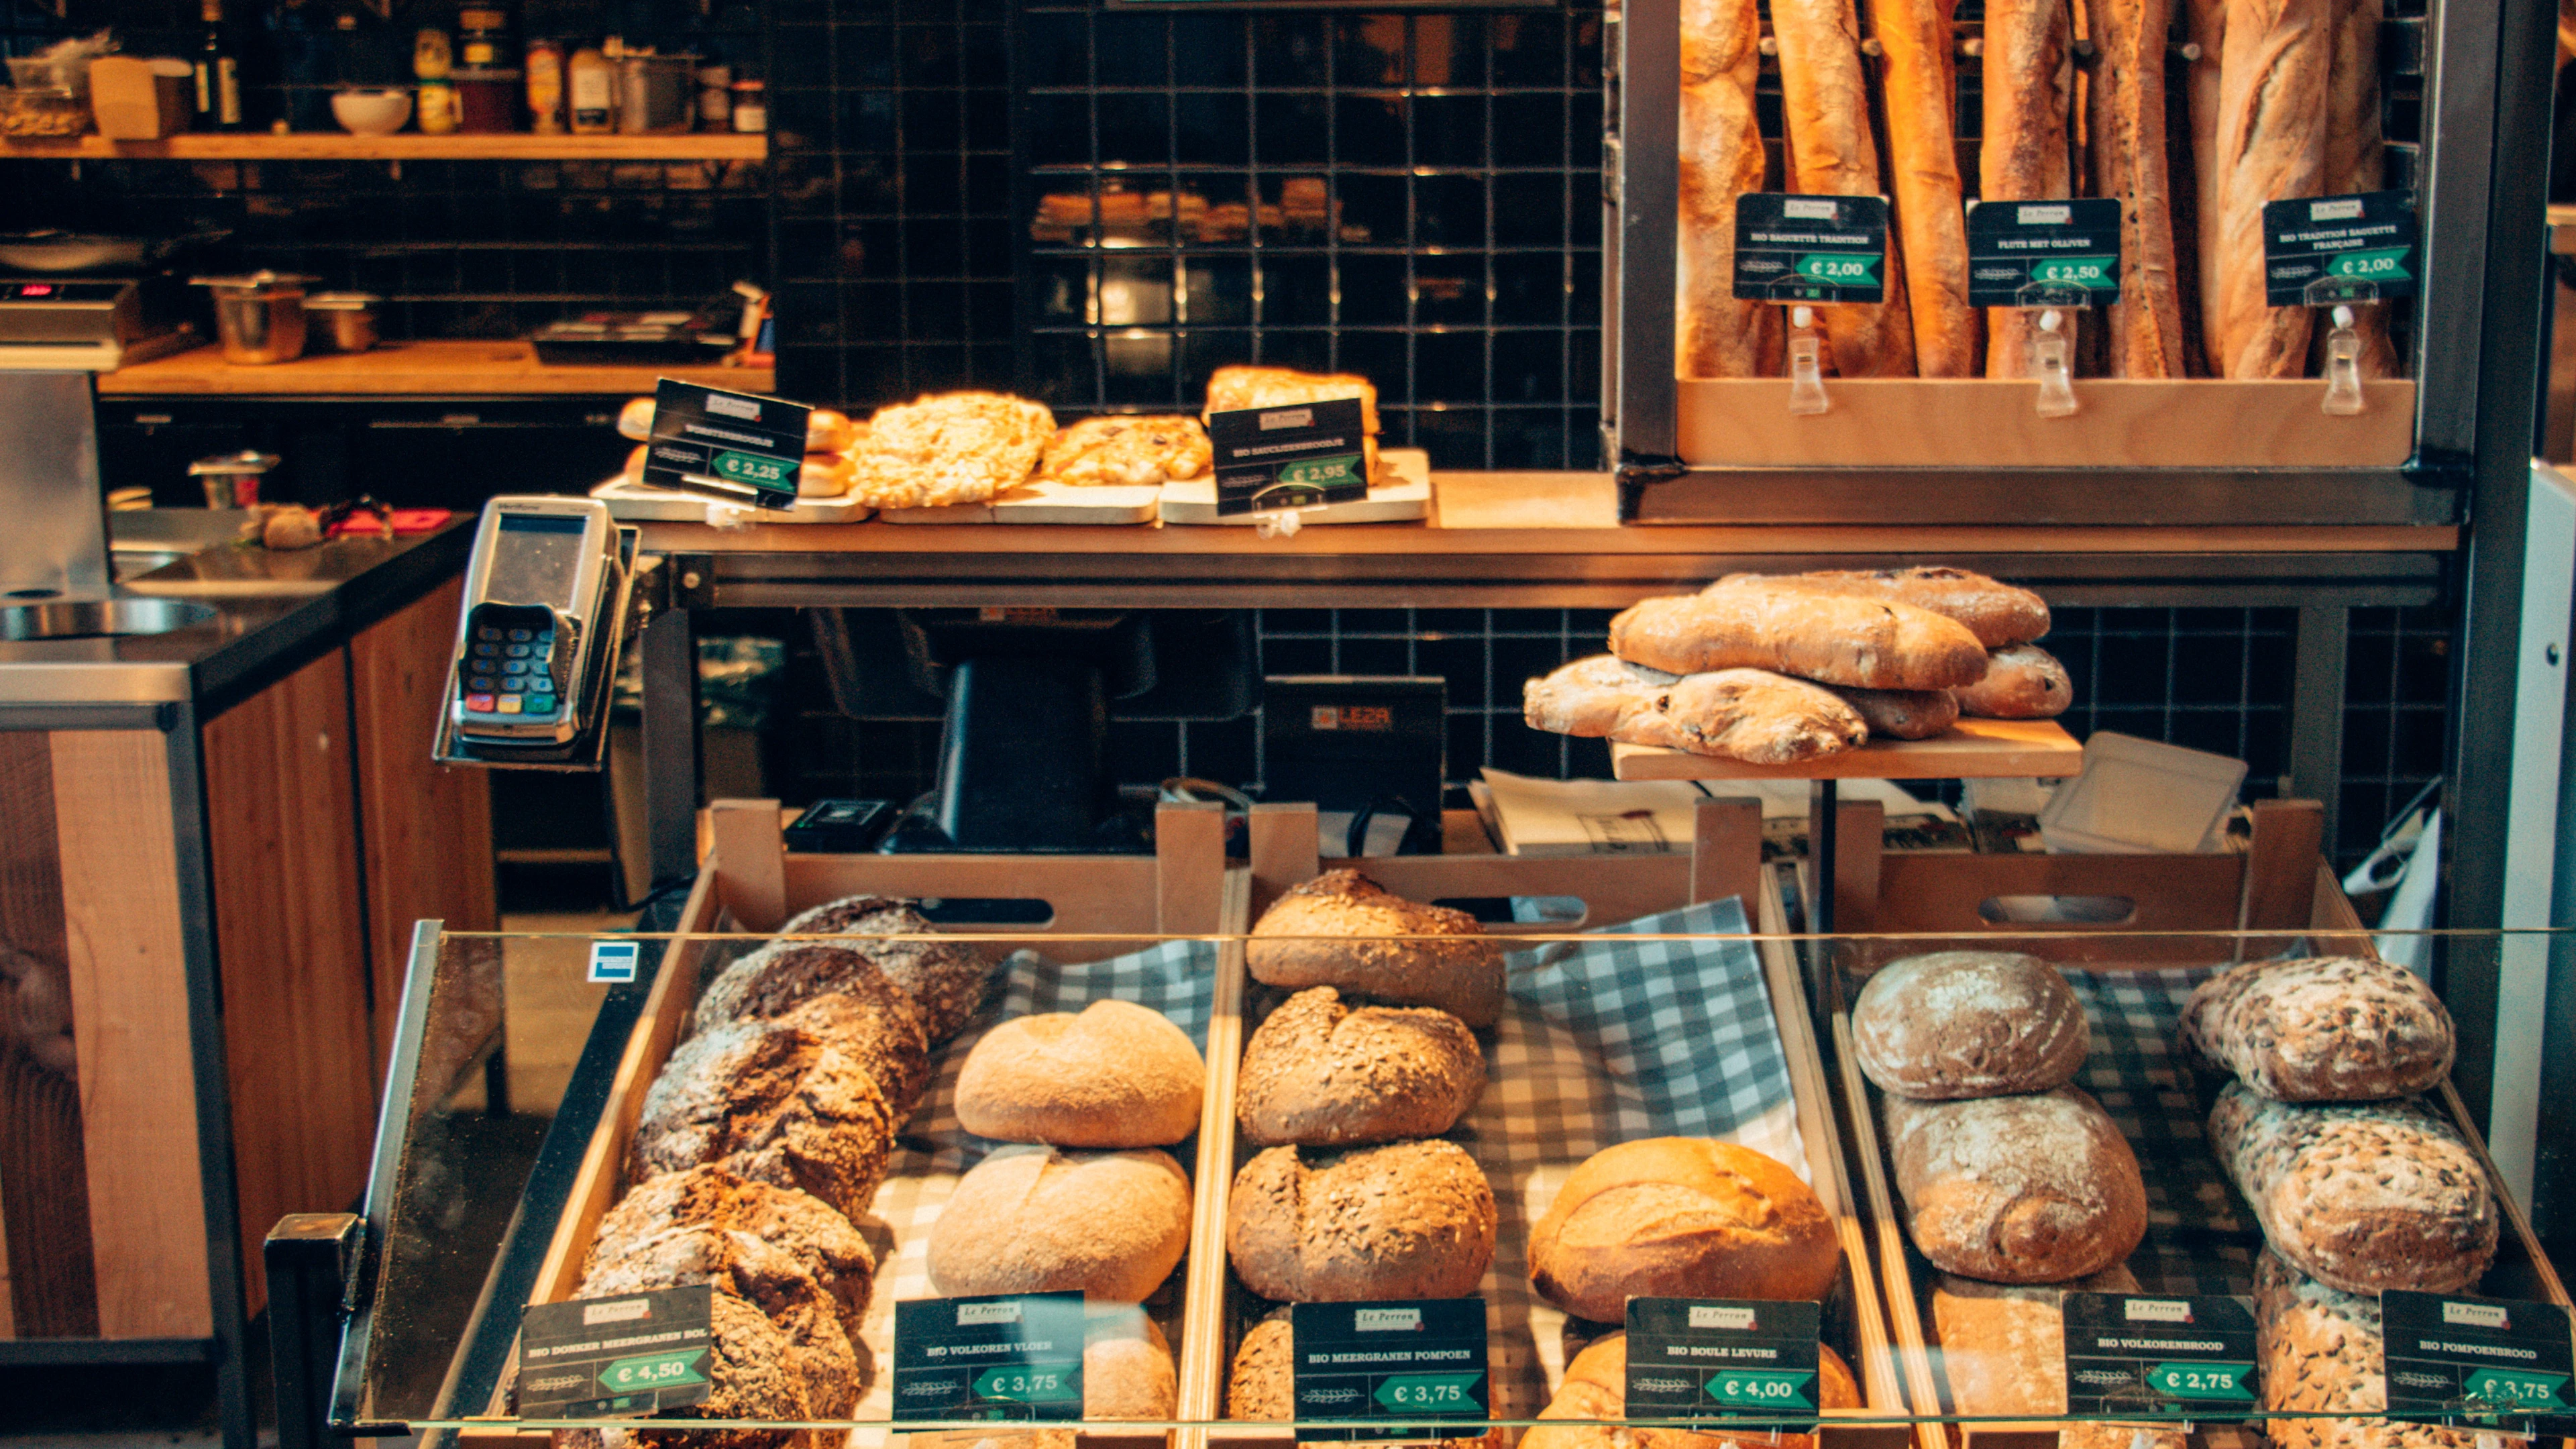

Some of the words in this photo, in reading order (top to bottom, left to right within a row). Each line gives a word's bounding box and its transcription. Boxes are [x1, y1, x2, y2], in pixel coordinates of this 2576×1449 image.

[1751, 233, 1767, 241] BIO
[1769, 233, 1817, 243] BAGUETTE
[1819, 235, 1870, 244] TRADITION
[2279, 234, 2296, 243] BIO
[2298, 230, 2347, 241] TRADITION
[2349, 225, 2396, 236] BAGUETTE
[1998, 240, 2027, 249] FLUTE
[2029, 240, 2049, 248] MET
[1811, 262, 1822, 274] €
[1827, 263, 1864, 276] 2,00
[2047, 266, 2057, 279] €
[2062, 266, 2100, 280] 2,50
[2342, 261, 2353, 274] €
[2359, 258, 2394, 273] 2,00
[1232, 449, 1250, 458] BIO
[727, 459, 739, 472] €
[743, 462, 780, 480] 2,25
[1293, 469, 1305, 482] €
[1309, 465, 1346, 481] 2,95
[965, 1307, 976, 1316] Le
[981, 1305, 1015, 1315] Perron
[1696, 1310, 1708, 1319] Le
[1712, 1311, 1747, 1320] Perron
[2132, 1303, 2144, 1311] Le
[2148, 1304, 2182, 1313] Perron
[2450, 1307, 2461, 1315] Le
[2465, 1308, 2500, 1318] Perron
[1362, 1313, 1374, 1322] Le
[1379, 1312, 1413, 1322] Perron
[529, 1348, 549, 1358] BIO
[551, 1342, 600, 1356] DONKER
[602, 1332, 682, 1348] MEERGRANEN
[683, 1328, 708, 1340] BOL
[927, 1347, 947, 1356] BIO
[950, 1343, 1011, 1355] VOLKOREN
[1014, 1341, 1053, 1352] VLOER
[2098, 1338, 2118, 1348] BIO
[2121, 1338, 2224, 1350] VOLKORENBROOD
[2419, 1340, 2440, 1350] BIO
[2443, 1342, 2537, 1360] POMPOENBROOD
[1309, 1354, 1330, 1364] BIO
[1332, 1351, 1411, 1362] MEERGRANEN
[1415, 1350, 1470, 1360] POMPOEN
[1667, 1346, 1688, 1356] BIO
[1690, 1346, 1729, 1357] BOULE
[1731, 1348, 1777, 1358] LEVURE
[617, 1368, 632, 1382] €
[638, 1362, 685, 1381] 4,50
[992, 1377, 1005, 1393] €
[1012, 1375, 1057, 1393] 3,75
[2166, 1373, 2180, 1387] €
[2187, 1373, 2233, 1391] 2,75
[1394, 1387, 1407, 1402] €
[1415, 1385, 1460, 1404] 3,75
[1725, 1381, 1739, 1395] €
[1746, 1382, 1792, 1399] 4,00
